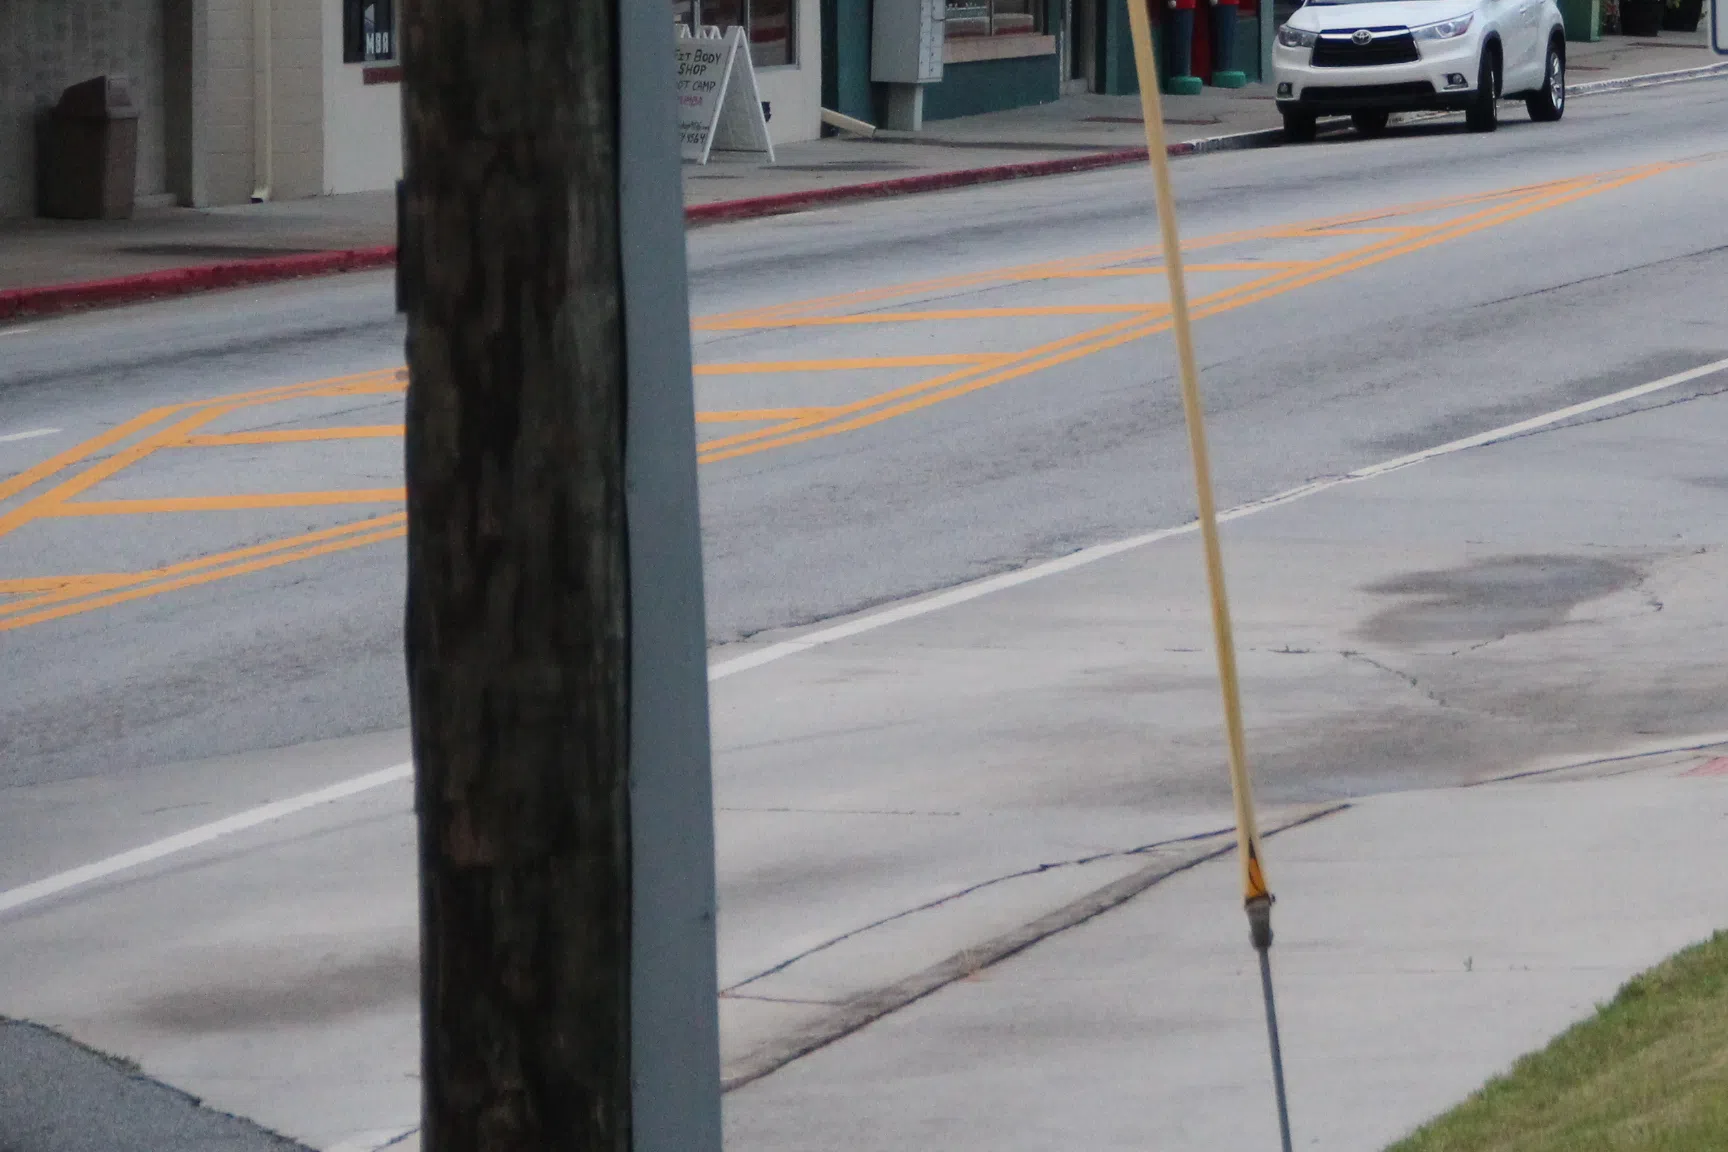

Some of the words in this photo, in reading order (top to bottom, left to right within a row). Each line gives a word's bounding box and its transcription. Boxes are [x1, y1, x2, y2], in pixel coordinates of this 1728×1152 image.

[694, 49, 722, 64] BODY
[678, 62, 707, 76] SHOP
[692, 80, 716, 93] CAMP
